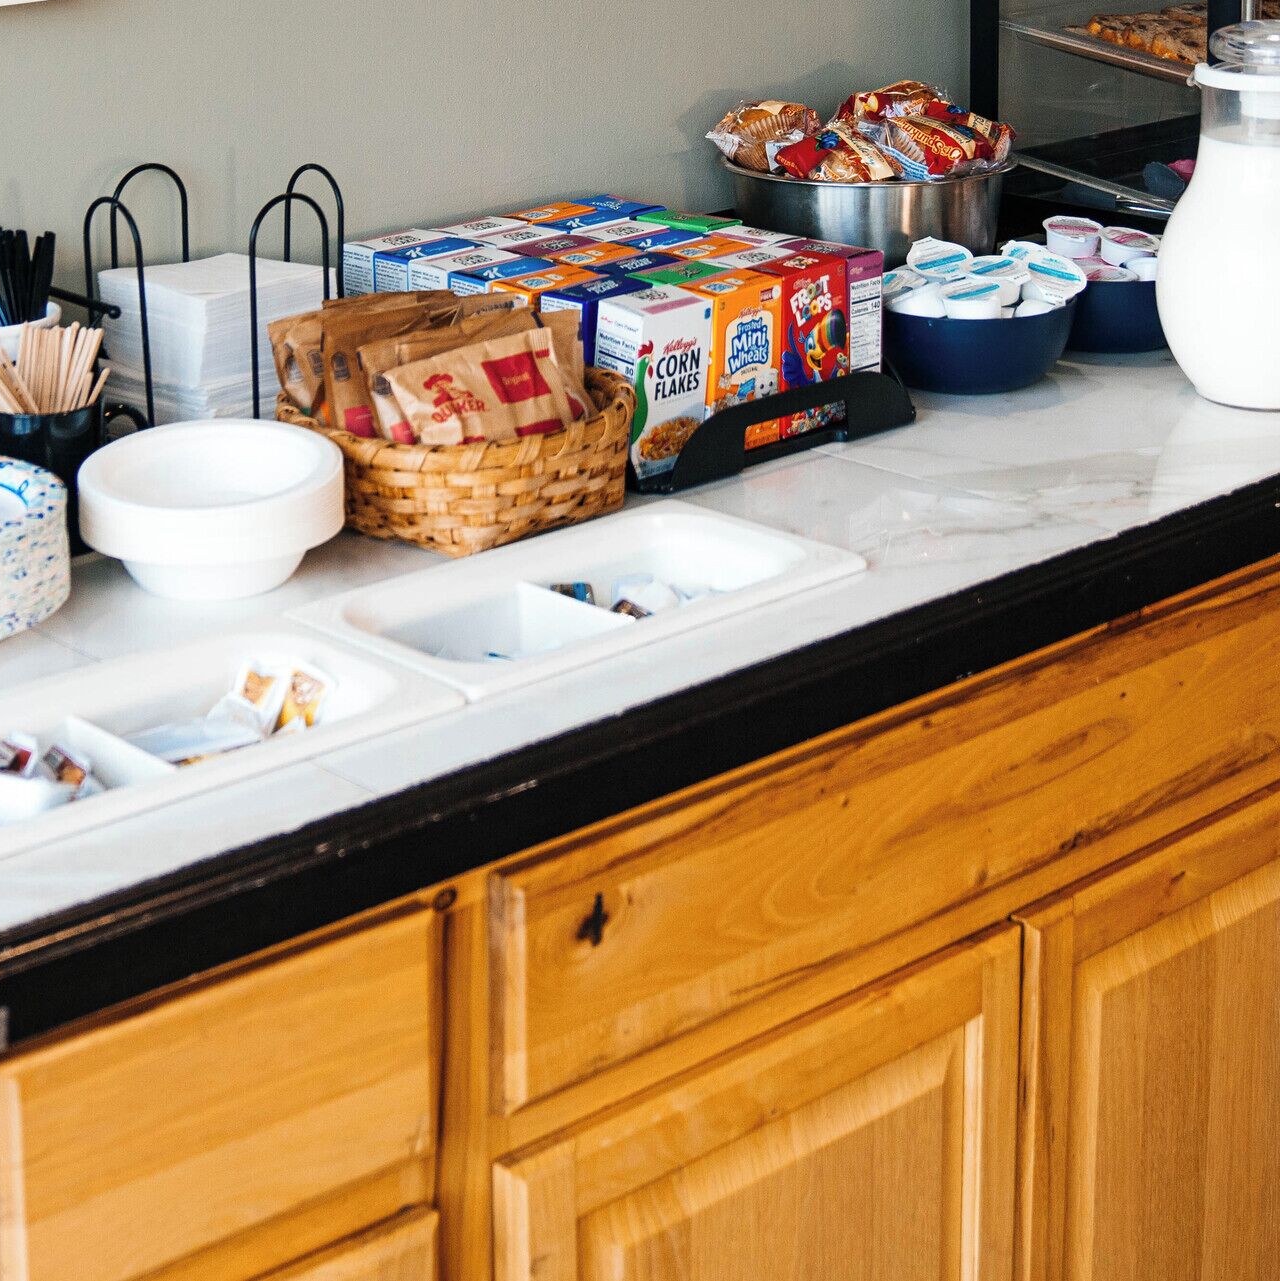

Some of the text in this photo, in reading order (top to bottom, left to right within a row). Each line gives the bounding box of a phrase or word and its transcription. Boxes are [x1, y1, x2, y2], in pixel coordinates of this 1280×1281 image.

[851, 282, 869, 290] Nutrition
[790, 274, 832, 328] FROOT LOOPS
[871, 300, 880, 310] 140
[599, 332, 636, 351] Nutrition Facts
[663, 336, 697, 355] Kellogg's
[729, 319, 768, 373] Frosted Mini Wheats
[597, 357, 618, 371] Calories
[655, 347, 701, 380] CORN
[654, 370, 700, 401] FLAKES
[431, 398, 486, 423] QUAKER
